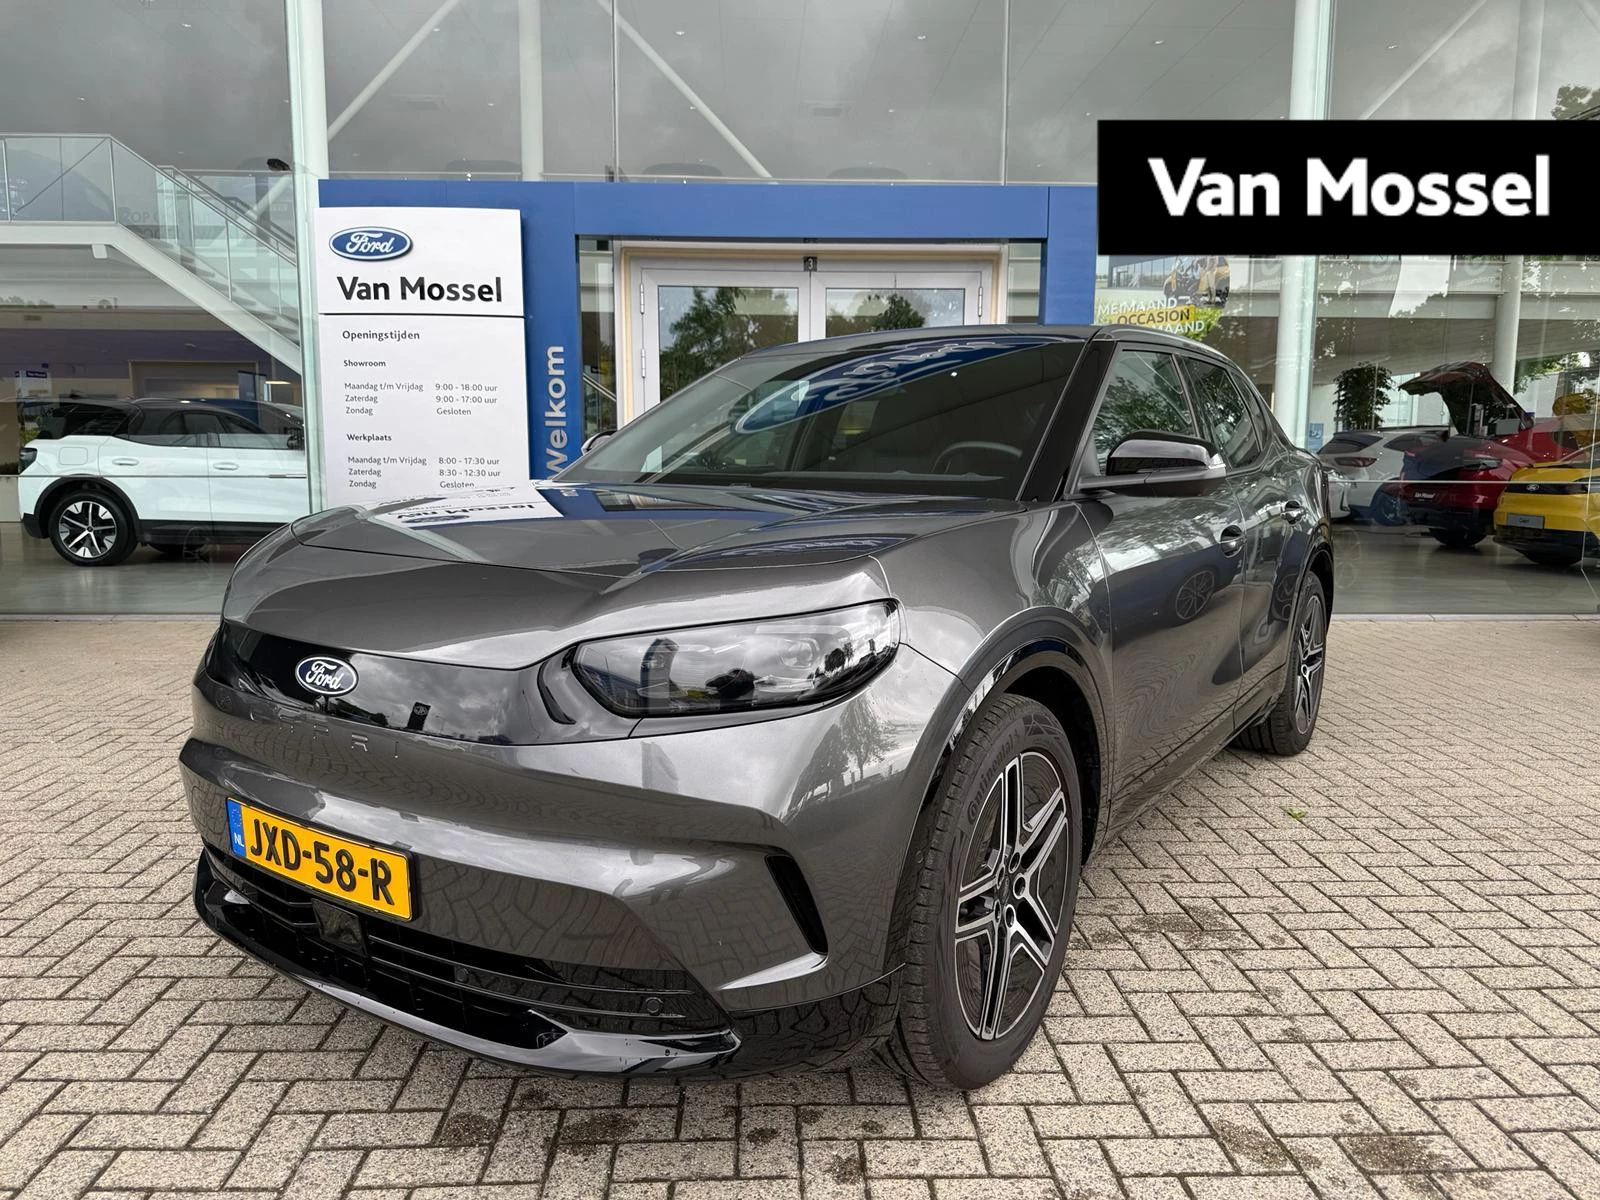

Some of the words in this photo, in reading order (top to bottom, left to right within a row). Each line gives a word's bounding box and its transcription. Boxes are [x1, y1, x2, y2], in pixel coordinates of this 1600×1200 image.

[345, 231, 396, 253] Ford
[336, 276, 390, 301] Van
[400, 276, 502, 302] Mossel
[1117, 308, 1190, 325] OCCASION
[342, 329, 420, 342] Openingstijden
[343, 359, 387, 367] Showroom
[344, 382, 379, 392] Maandag
[380, 382, 395, 390] t/m
[395, 382, 424, 393] Vrijdag
[435, 383, 454, 391] 9:00
[345, 394, 379, 404] Zaterdag
[435, 395, 454, 403] 9:00
[461, 395, 483, 403] 17:00
[345, 406, 374, 416] Zondag
[436, 407, 472, 415] Gesloten
[346, 433, 392, 443] Werkplaats
[347, 456, 382, 466] Maandag
[383, 456, 398, 464] t/m
[398, 456, 427, 466] Vrijdag
[438, 457, 457, 465] 8:00
[464, 457, 486, 465] 17:30
[348, 467, 382, 478] Zaterdag
[439, 469, 458, 477] 8:30
[464, 469, 487, 477] 12:30
[348, 479, 377, 490] Zondag
[439, 480, 475, 489] Gesloten
[233, 832, 244, 848] NL
[250, 818, 396, 906] JXD-58-R
